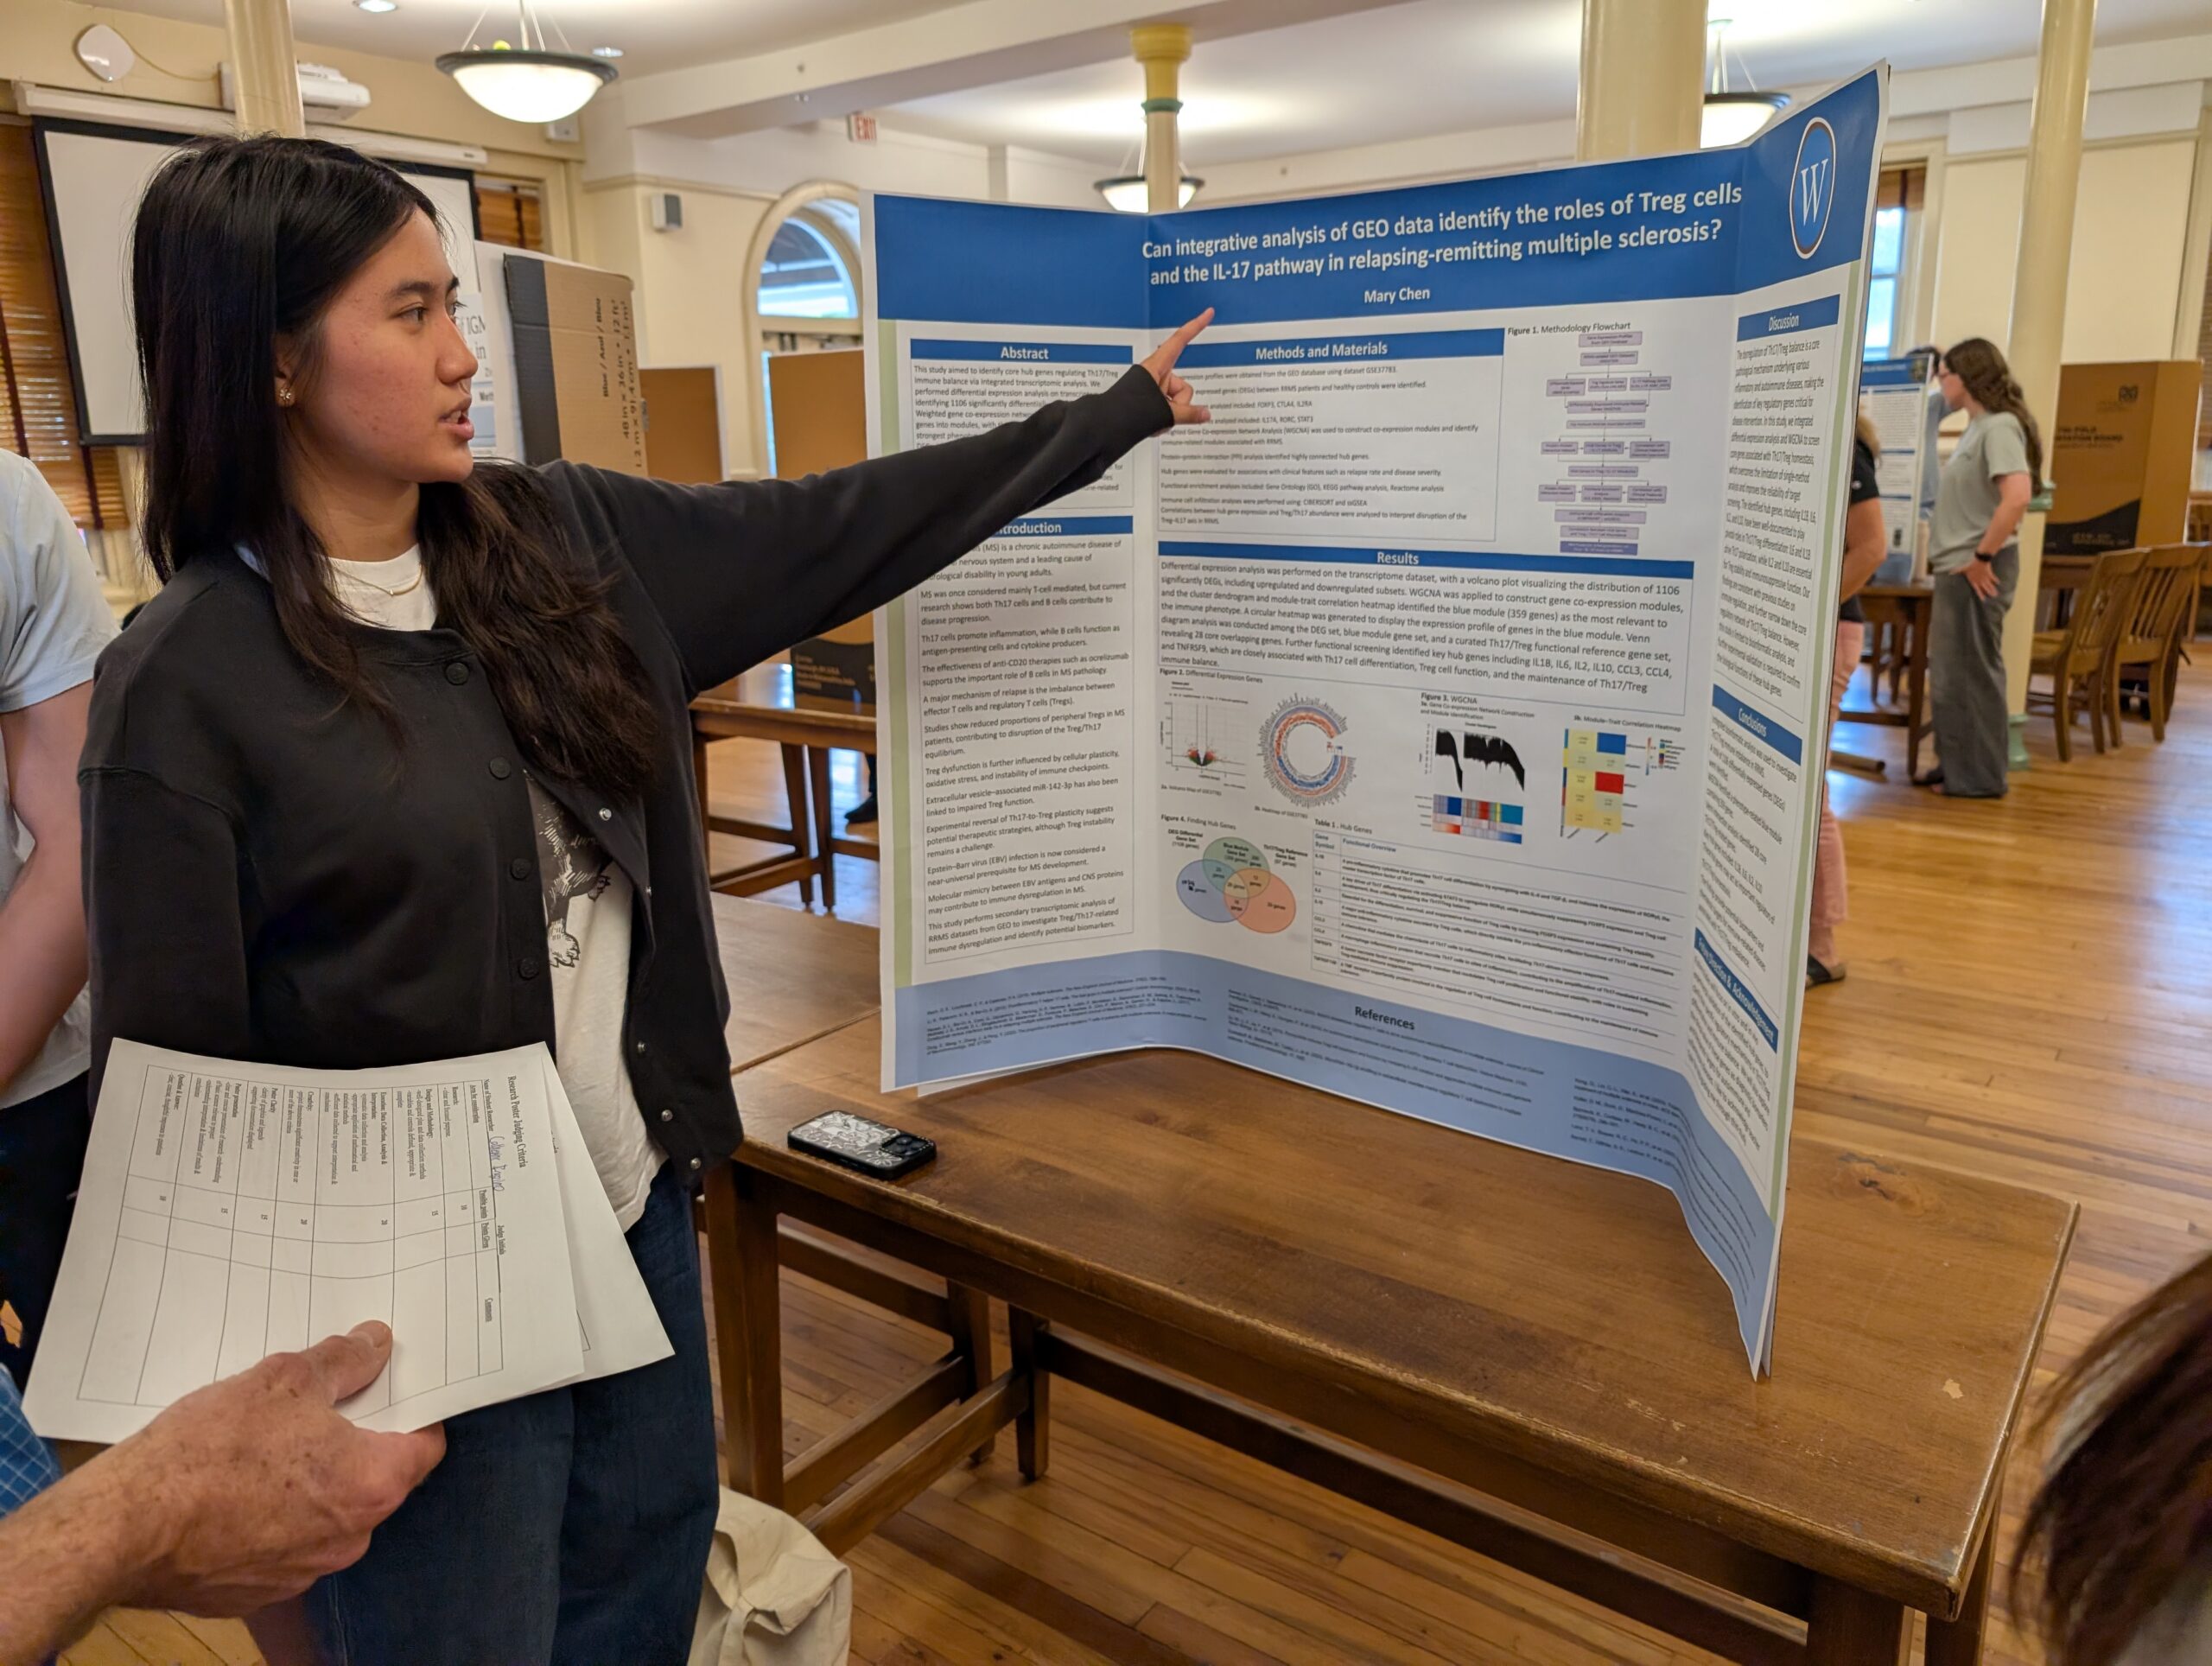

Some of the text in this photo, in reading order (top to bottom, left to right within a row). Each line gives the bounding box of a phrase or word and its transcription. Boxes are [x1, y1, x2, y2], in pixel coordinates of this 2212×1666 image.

[1801, 158, 1828, 226] W
[1141, 181, 1741, 258] Can integrative analysis of GEO data identify the roles of Treg cells
[1150, 219, 1721, 284] and the IL-17 pathway in relapsing-remitting multiple sclerosis?
[1363, 287, 1430, 304] Mary Chen
[613, 319, 620, 334] 12
[1508, 326, 1529, 336] Figure
[1541, 323, 1591, 334] Methodology
[1592, 321, 1630, 330] Flowchart
[1769, 313, 1799, 332] Discussion
[1001, 347, 1049, 359] Abstract
[1255, 342, 1388, 360] Methods and Materials
[619, 371, 626, 387] 36
[928, 366, 946, 376] study
[978, 366, 1003, 377] identify
[1054, 368, 1085, 378] regulating
[1087, 369, 1120, 379] Th17/Treg
[998, 522, 1062, 534] troduction
[1376, 551, 1420, 564] Results
[1161, 562, 1199, 571] Differential
[1201, 563, 1236, 575] expression
[1238, 565, 1265, 576] analysis
[1282, 567, 1321, 579] performed
[1334, 569, 1346, 578] the
[1349, 569, 1403, 583] transcriptome
[1405, 572, 1436, 585] dataset,
[1439, 574, 1458, 583] with
[1466, 575, 1499, 586] volcano
[1502, 577, 1518, 589] plot
[1521, 578, 1567, 591] visualizing
[1569, 581, 1584, 589] the
[1586, 582, 1640, 593] distribution
[1643, 584, 1653, 593] of
[1656, 585, 1679, 595] 1106
[1161, 629, 1192, 642] revealing
[1220, 633, 1259, 646] overlapping
[1261, 638, 1283, 648] genes.
[1285, 638, 1312, 648] Further
[1314, 639, 1351, 651] functional
[1353, 643, 1389, 657] screening
[1392, 645, 1430, 657] identified
[1432, 649, 1446, 661] key
[1447, 650, 1464, 660] hub
[1465, 654, 1490, 664] genes
[1491, 654, 1530, 668] including
[1555, 659, 1571, 671] IL6,
[1574, 660, 1590, 672] IL2,
[1592, 662, 1614, 675] IL10,
[1617, 664, 1643, 677] CCL3,
[1645, 666, 1671, 679] CCL4,
[1421, 692, 1440, 703] Figure
[1451, 695, 1477, 703] WGCNA
[1738, 708, 1766, 737] Conclusions
[928, 921, 942, 930] This
[944, 919, 963, 929] study
[963, 913, 994, 926] performs
[995, 907, 1029, 921] secondary
[1030, 900, 1078, 915] transcriptomic
[1080, 898, 1106, 908] analysis
[1355, 1006, 1415, 1030] References
[508, 1076, 528, 1168] Research Poster Judging Criteria
